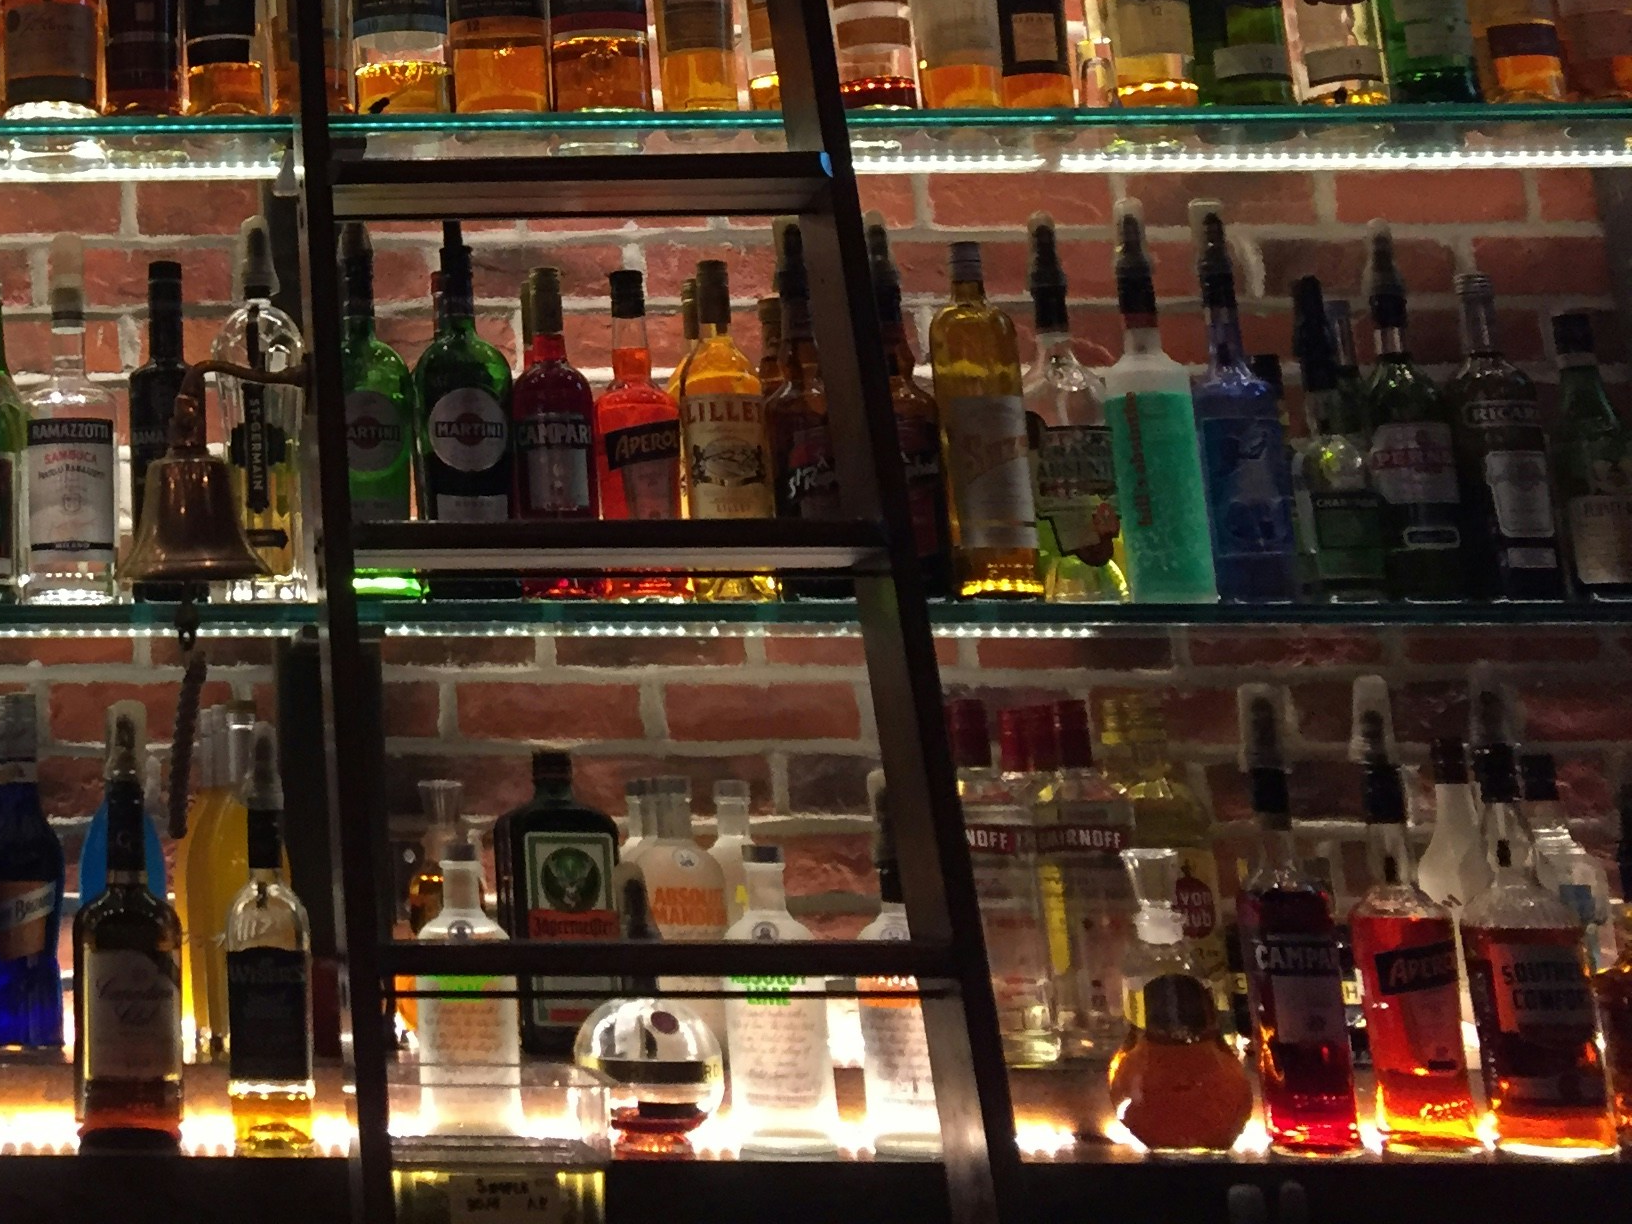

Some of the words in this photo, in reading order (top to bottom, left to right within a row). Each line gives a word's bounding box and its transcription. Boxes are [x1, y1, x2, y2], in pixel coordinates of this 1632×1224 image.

[32, 423, 109, 440] RAMAZZOTTI
[346, 425, 400, 441] ARTINI
[437, 421, 504, 438] MARTINI
[248, 397, 264, 491] ST-GERMAIN
[43, 449, 97, 466] SAMBUCA
[964, 828, 1008, 850] NOFF
[1255, 943, 1338, 971] CAMPA
